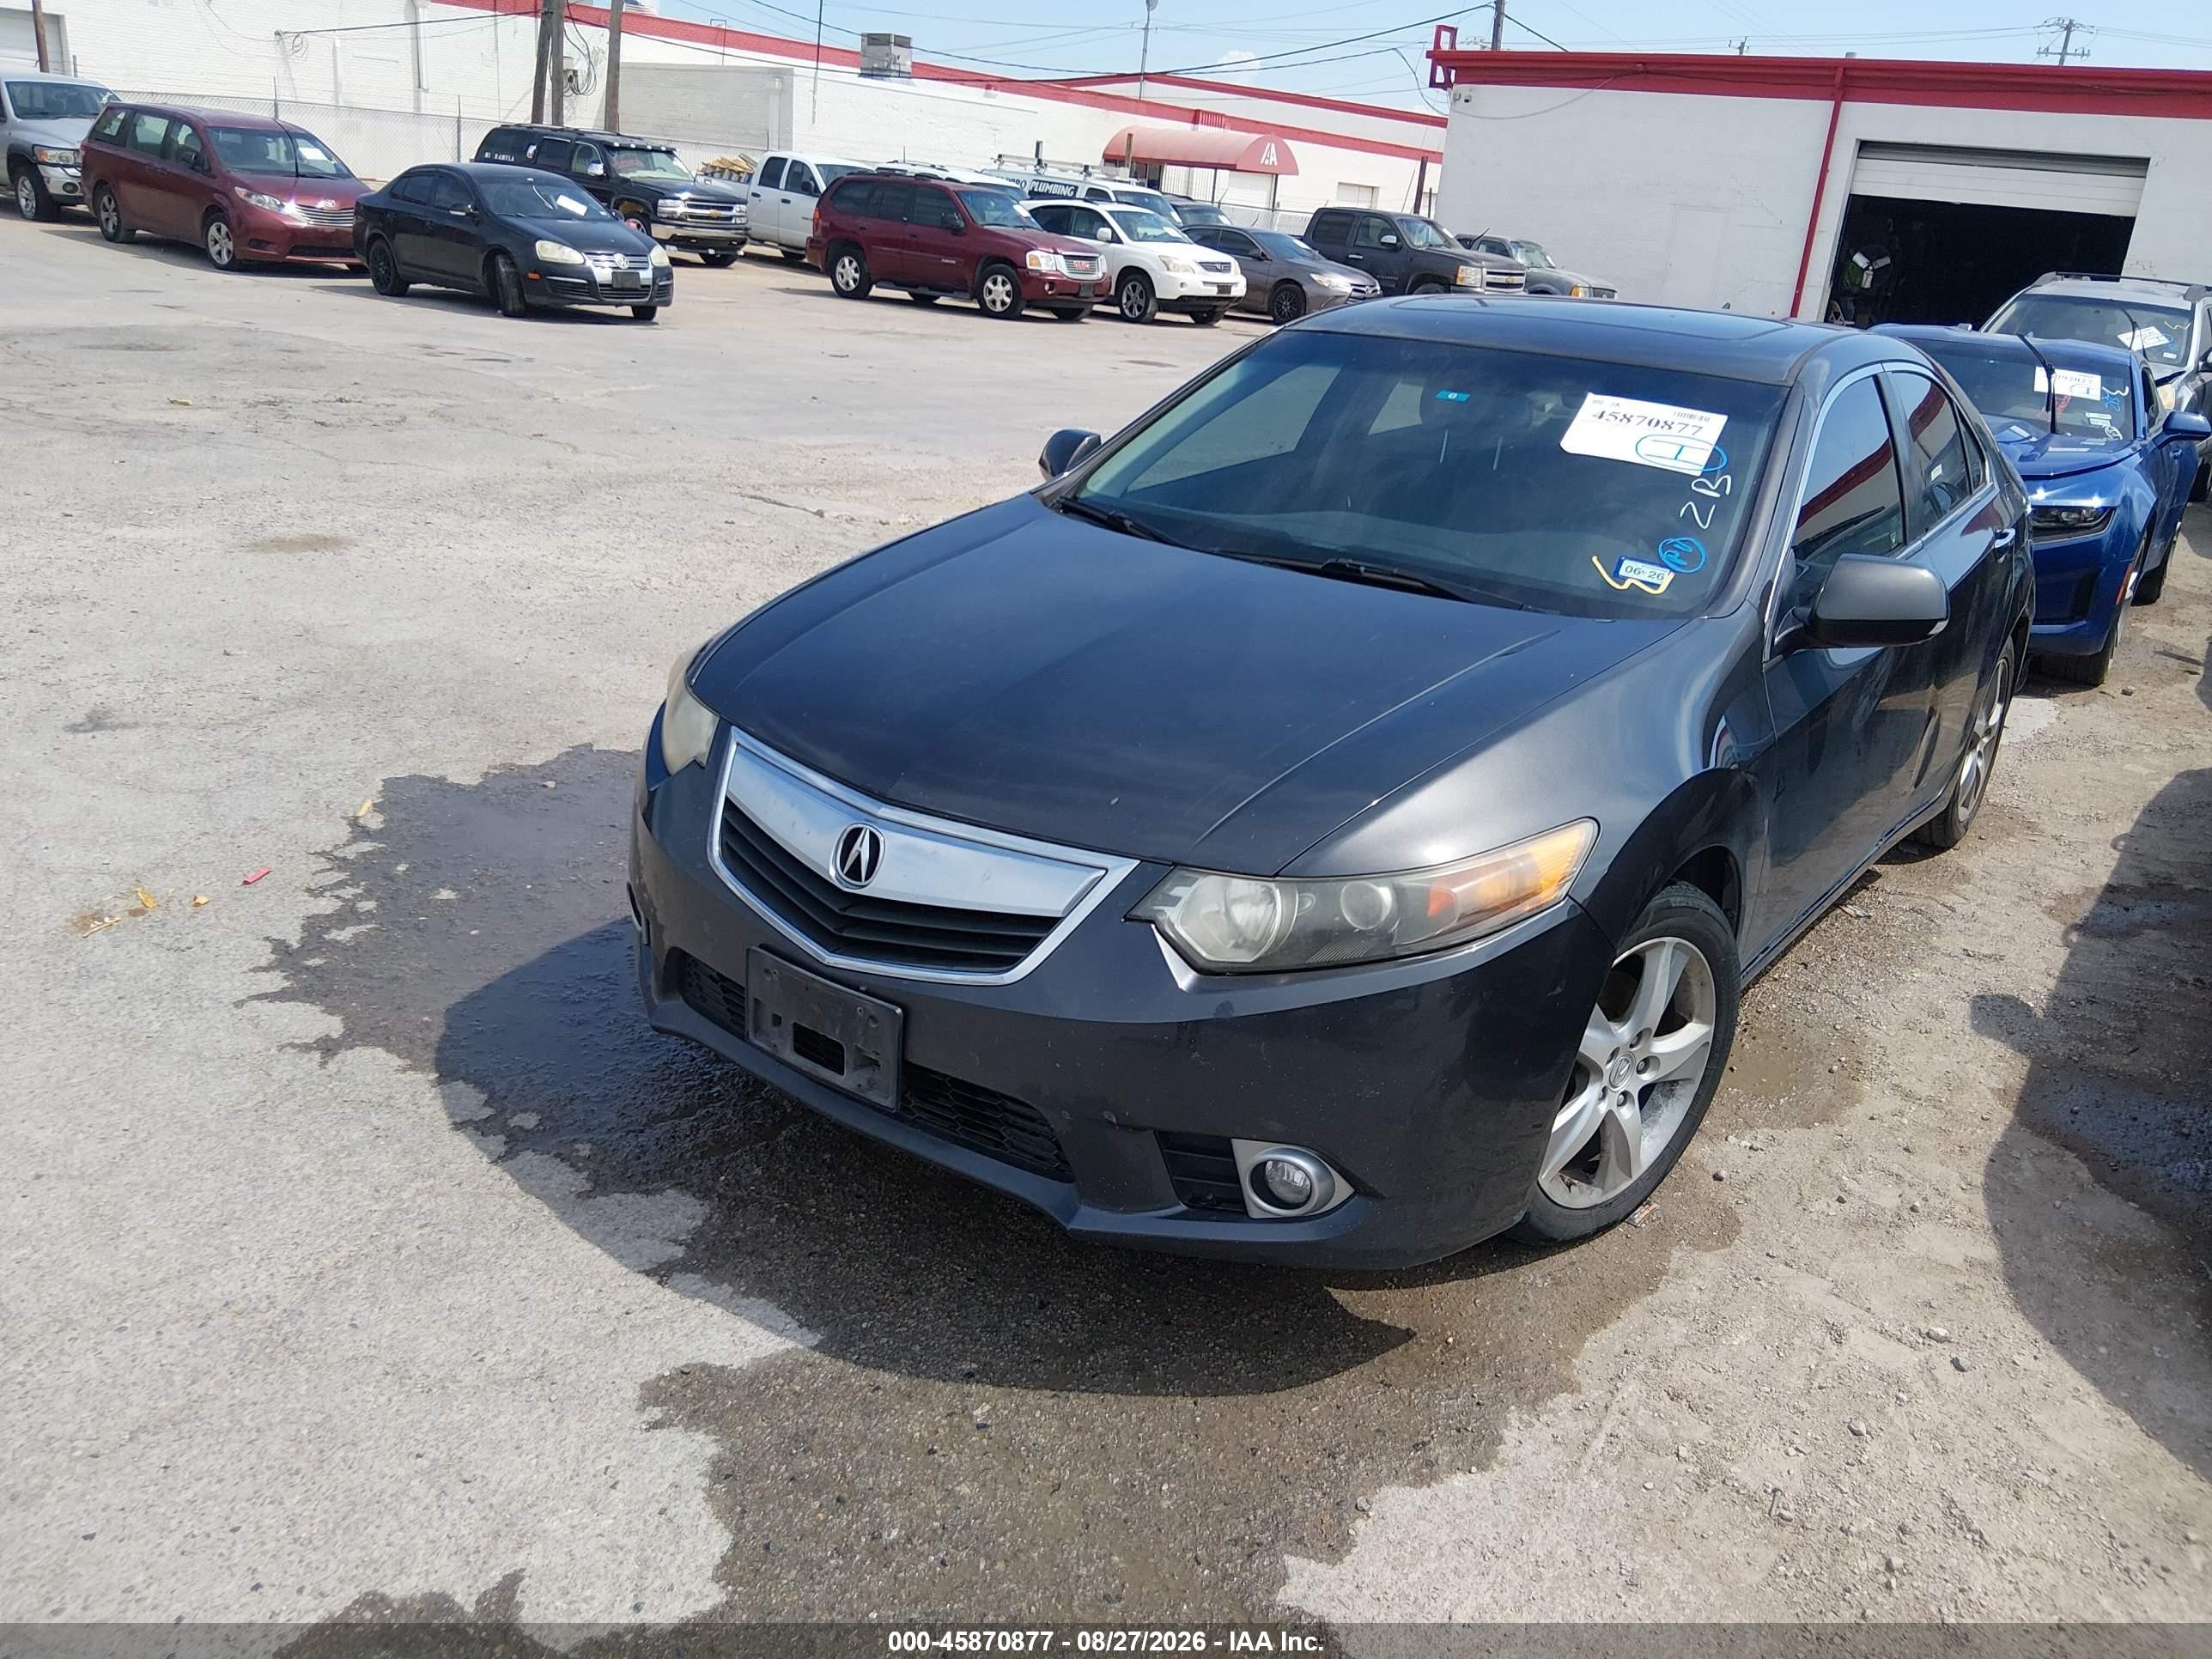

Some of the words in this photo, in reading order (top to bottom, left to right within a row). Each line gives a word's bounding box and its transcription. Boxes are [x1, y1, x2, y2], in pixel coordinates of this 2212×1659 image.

[1030, 180, 1075, 198] PLUMBING
[1592, 410, 1703, 435] 45870877
[1625, 565, 1641, 575] 06
[1647, 570, 1665, 581] 26
